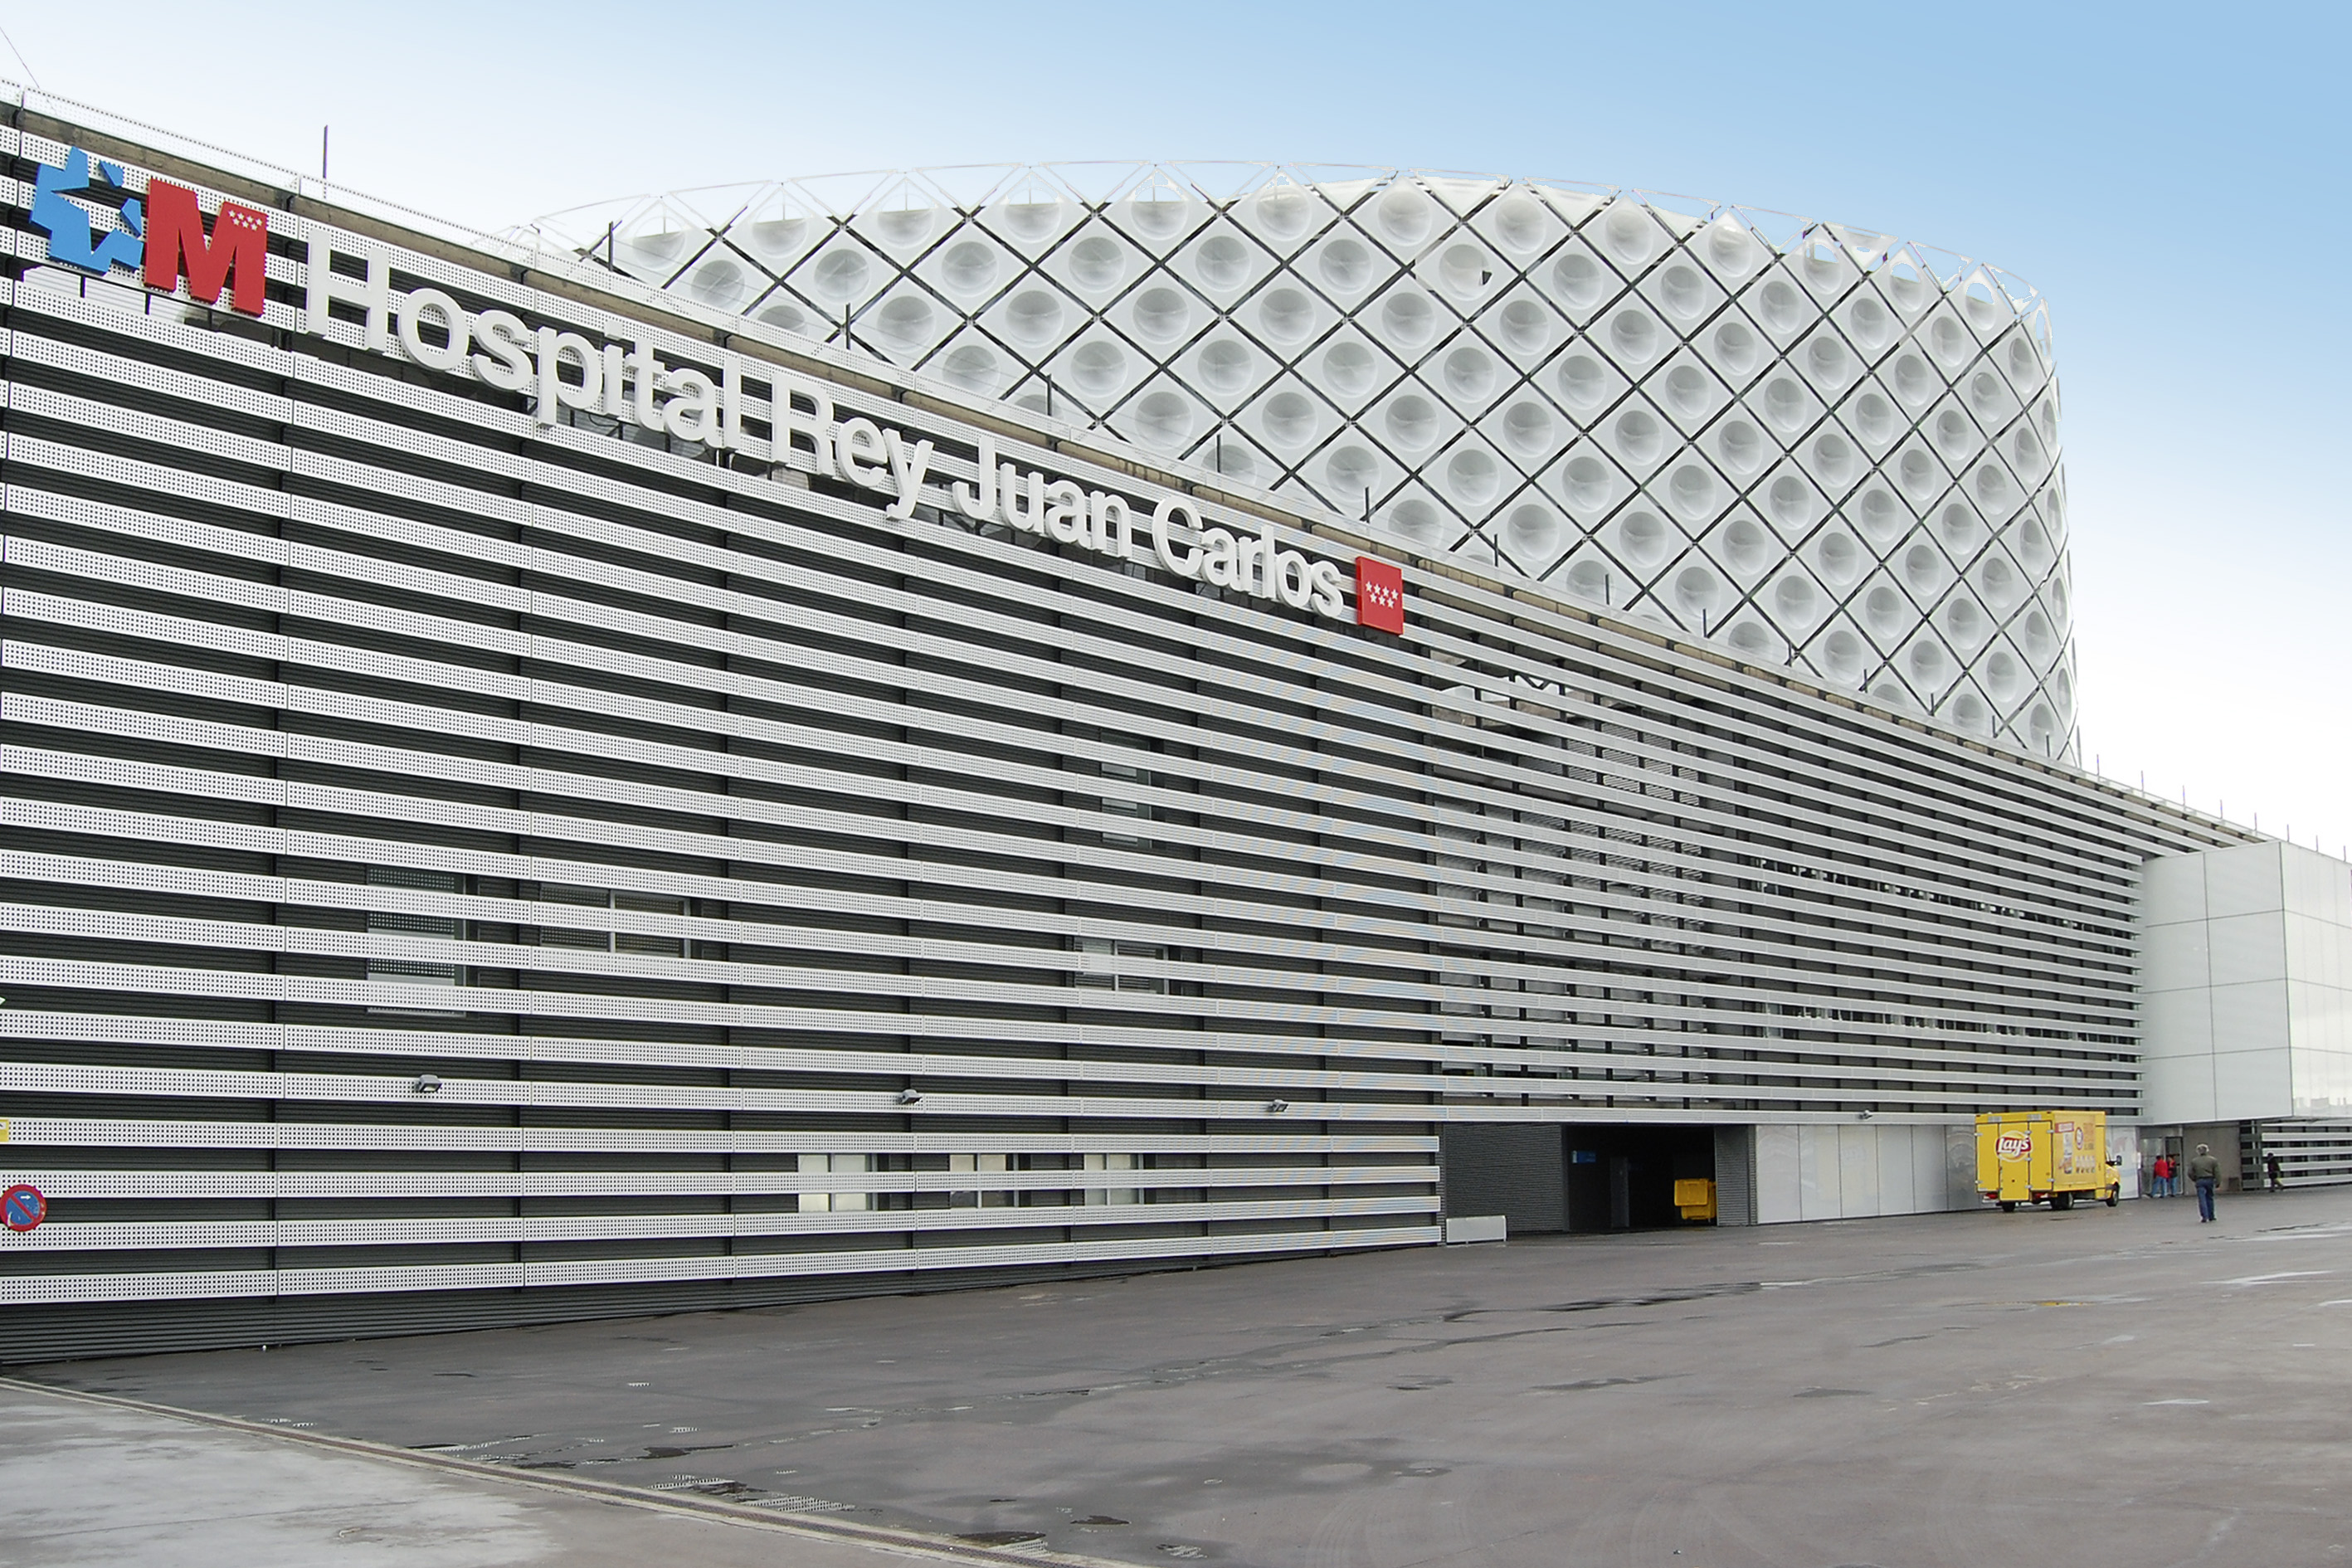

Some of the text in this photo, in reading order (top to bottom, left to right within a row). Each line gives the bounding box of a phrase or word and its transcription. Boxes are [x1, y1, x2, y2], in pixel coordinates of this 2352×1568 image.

[306, 227, 740, 450] Hospital
[771, 370, 933, 520] Rey
[952, 436, 1133, 558] Juan
[1152, 498, 1345, 618] Carlos
